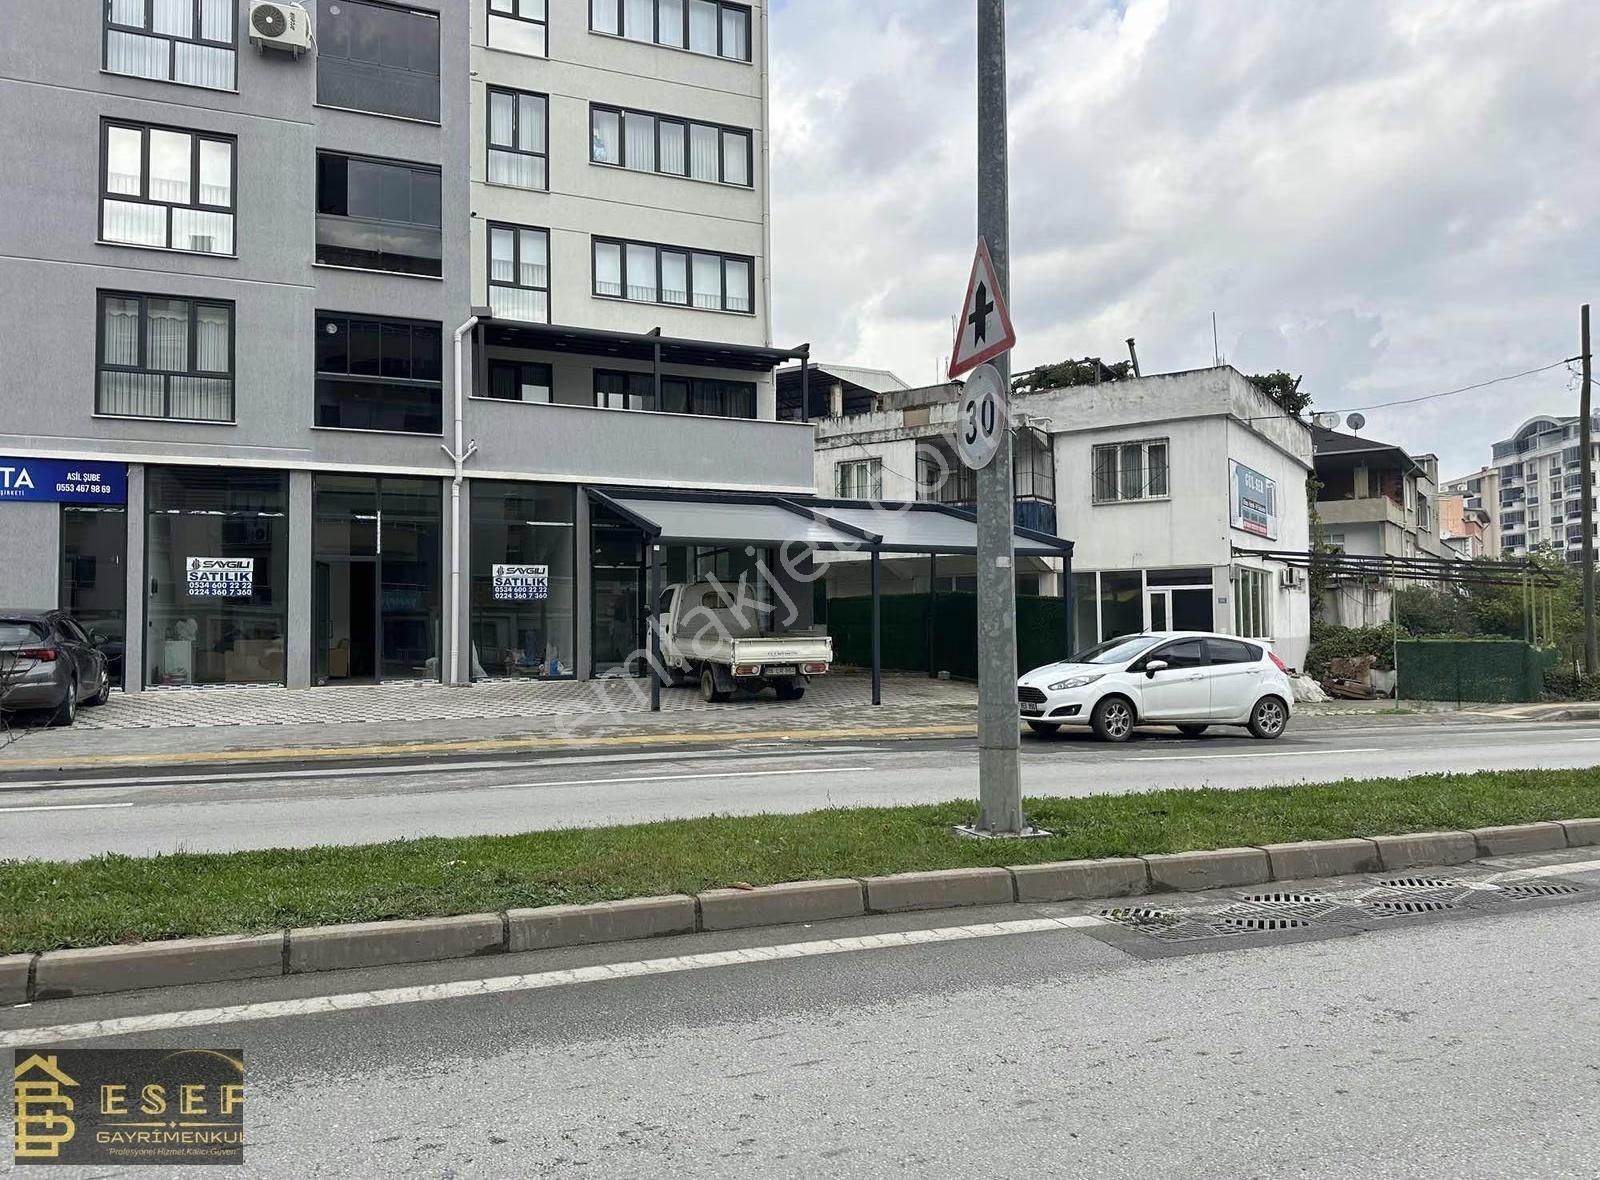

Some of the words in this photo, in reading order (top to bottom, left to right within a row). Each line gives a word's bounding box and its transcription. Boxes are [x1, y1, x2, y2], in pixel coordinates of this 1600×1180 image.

[965, 392, 995, 445] 30
[67, 472, 82, 481] ASİL
[83, 473, 101, 482] ŞUBE
[56, 483, 75, 492] 0553
[76, 484, 89, 493] 467
[91, 485, 100, 493] 98
[101, 485, 111, 493] 69
[203, 560, 250, 569] SAYGILI
[506, 567, 545, 575] SAYGILI
[189, 572, 250, 581] SATILIK
[495, 578, 545, 586] SATILIK
[189, 588, 209, 596] 0224
[211, 588, 227, 596] 360
[236, 588, 252, 596] 360
